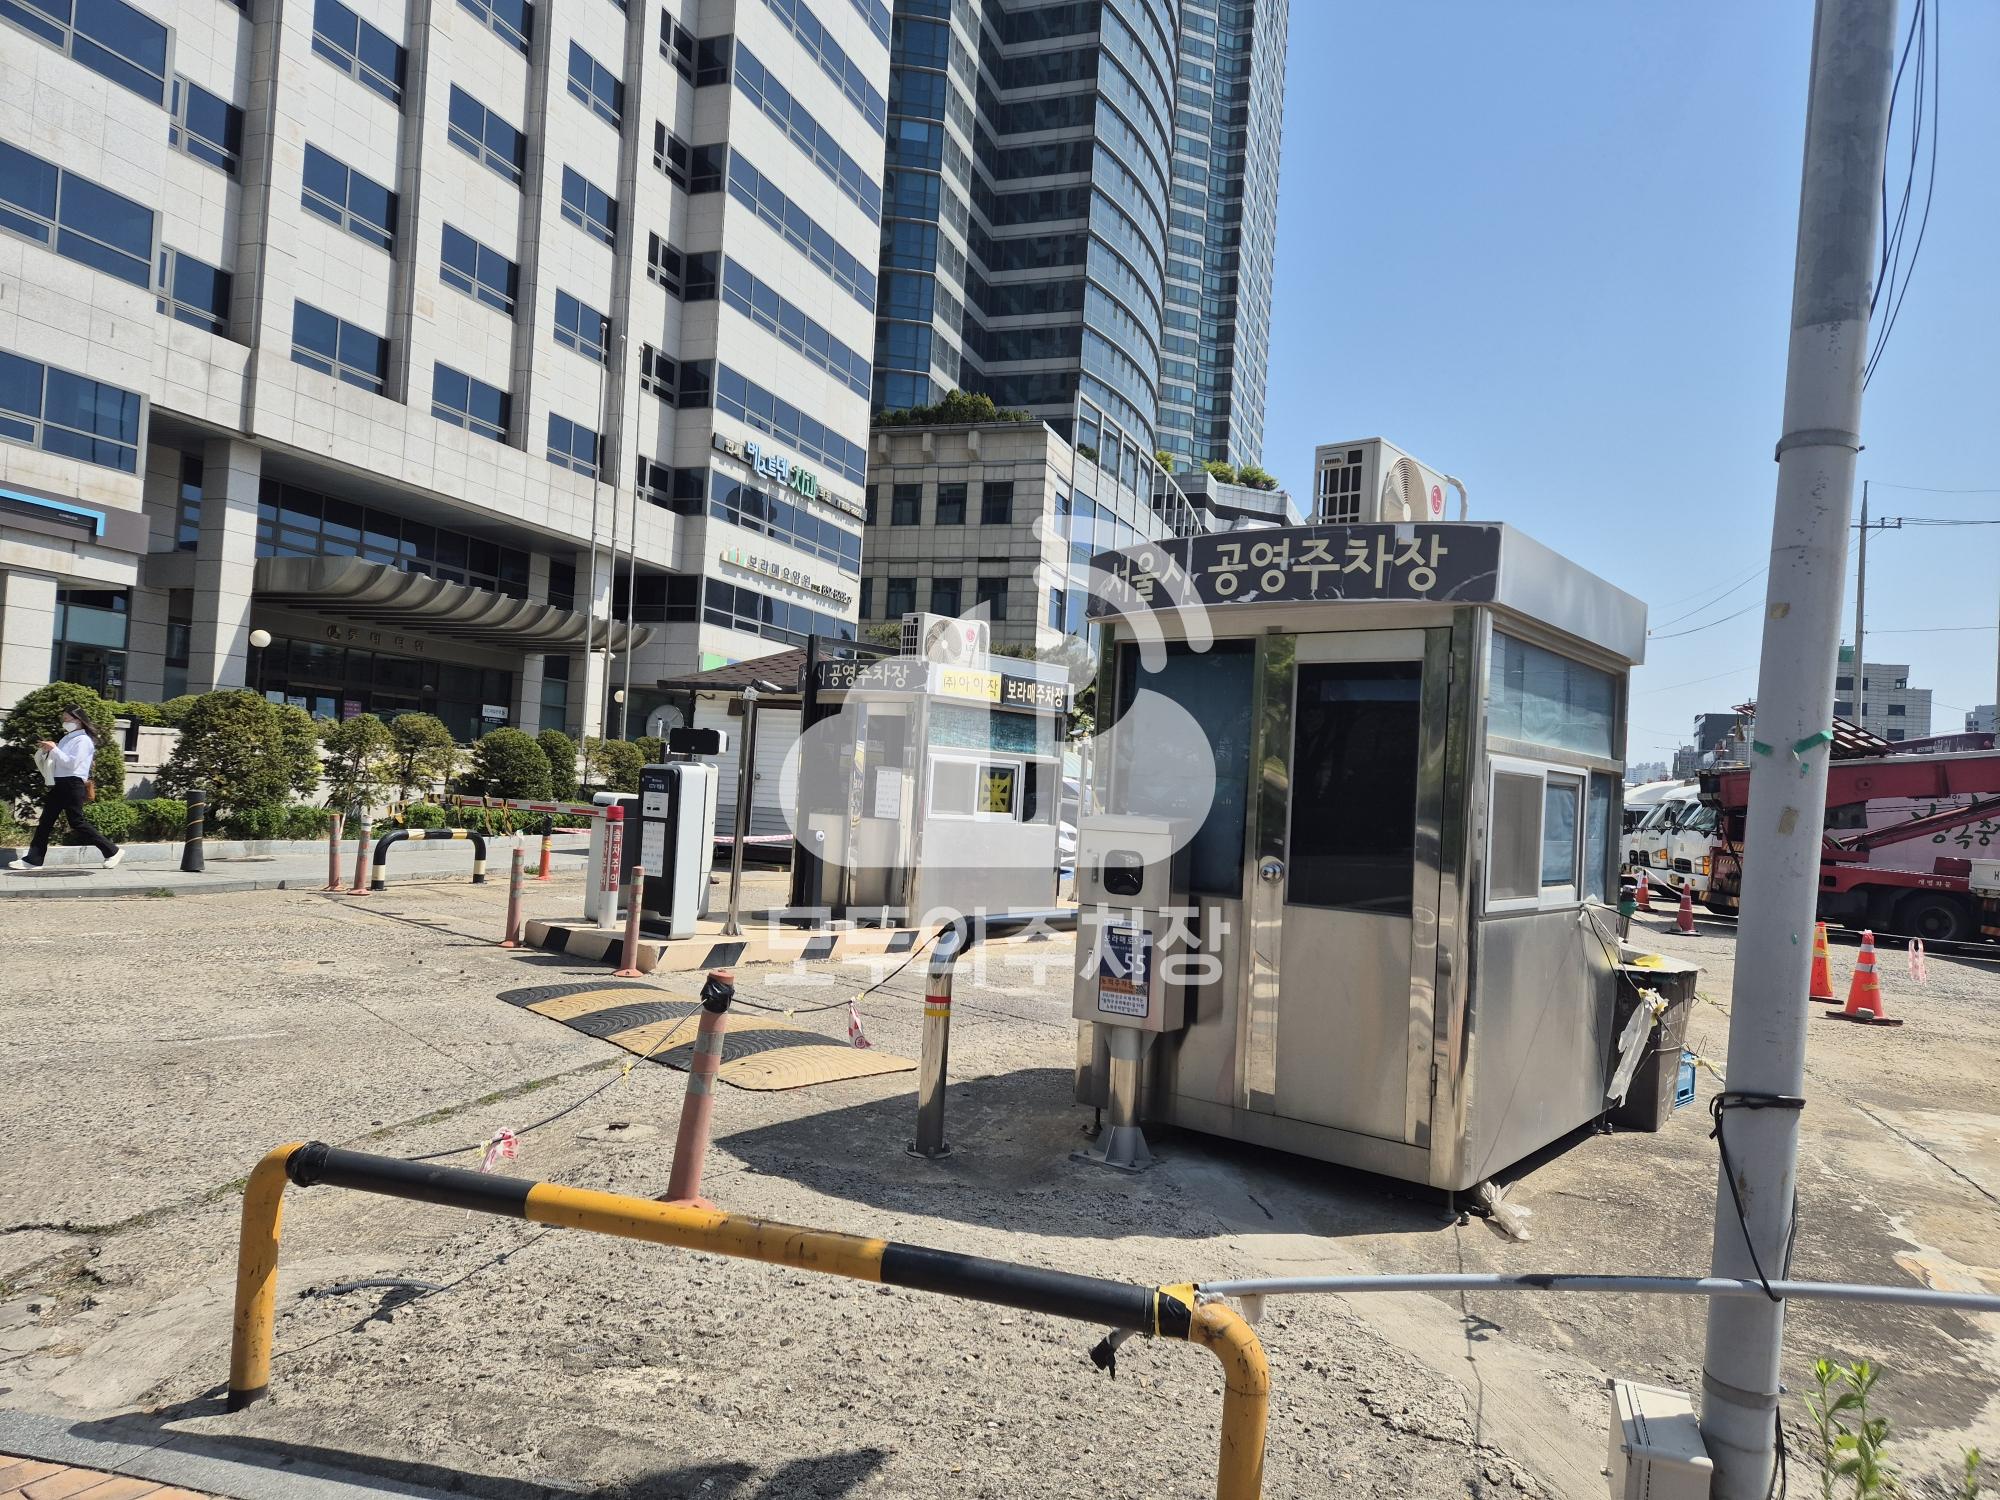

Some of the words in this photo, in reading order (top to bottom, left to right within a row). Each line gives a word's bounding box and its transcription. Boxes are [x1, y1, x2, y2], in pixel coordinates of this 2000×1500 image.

[748, 555, 811, 588] 보라매요양원
[1108, 549, 1191, 601] 서울시
[1207, 533, 1448, 596] 공영주차장
[829, 664, 910, 688] 공영주차장
[1007, 680, 1065, 708] 보라매주차장
[1124, 952, 1146, 975] 55
